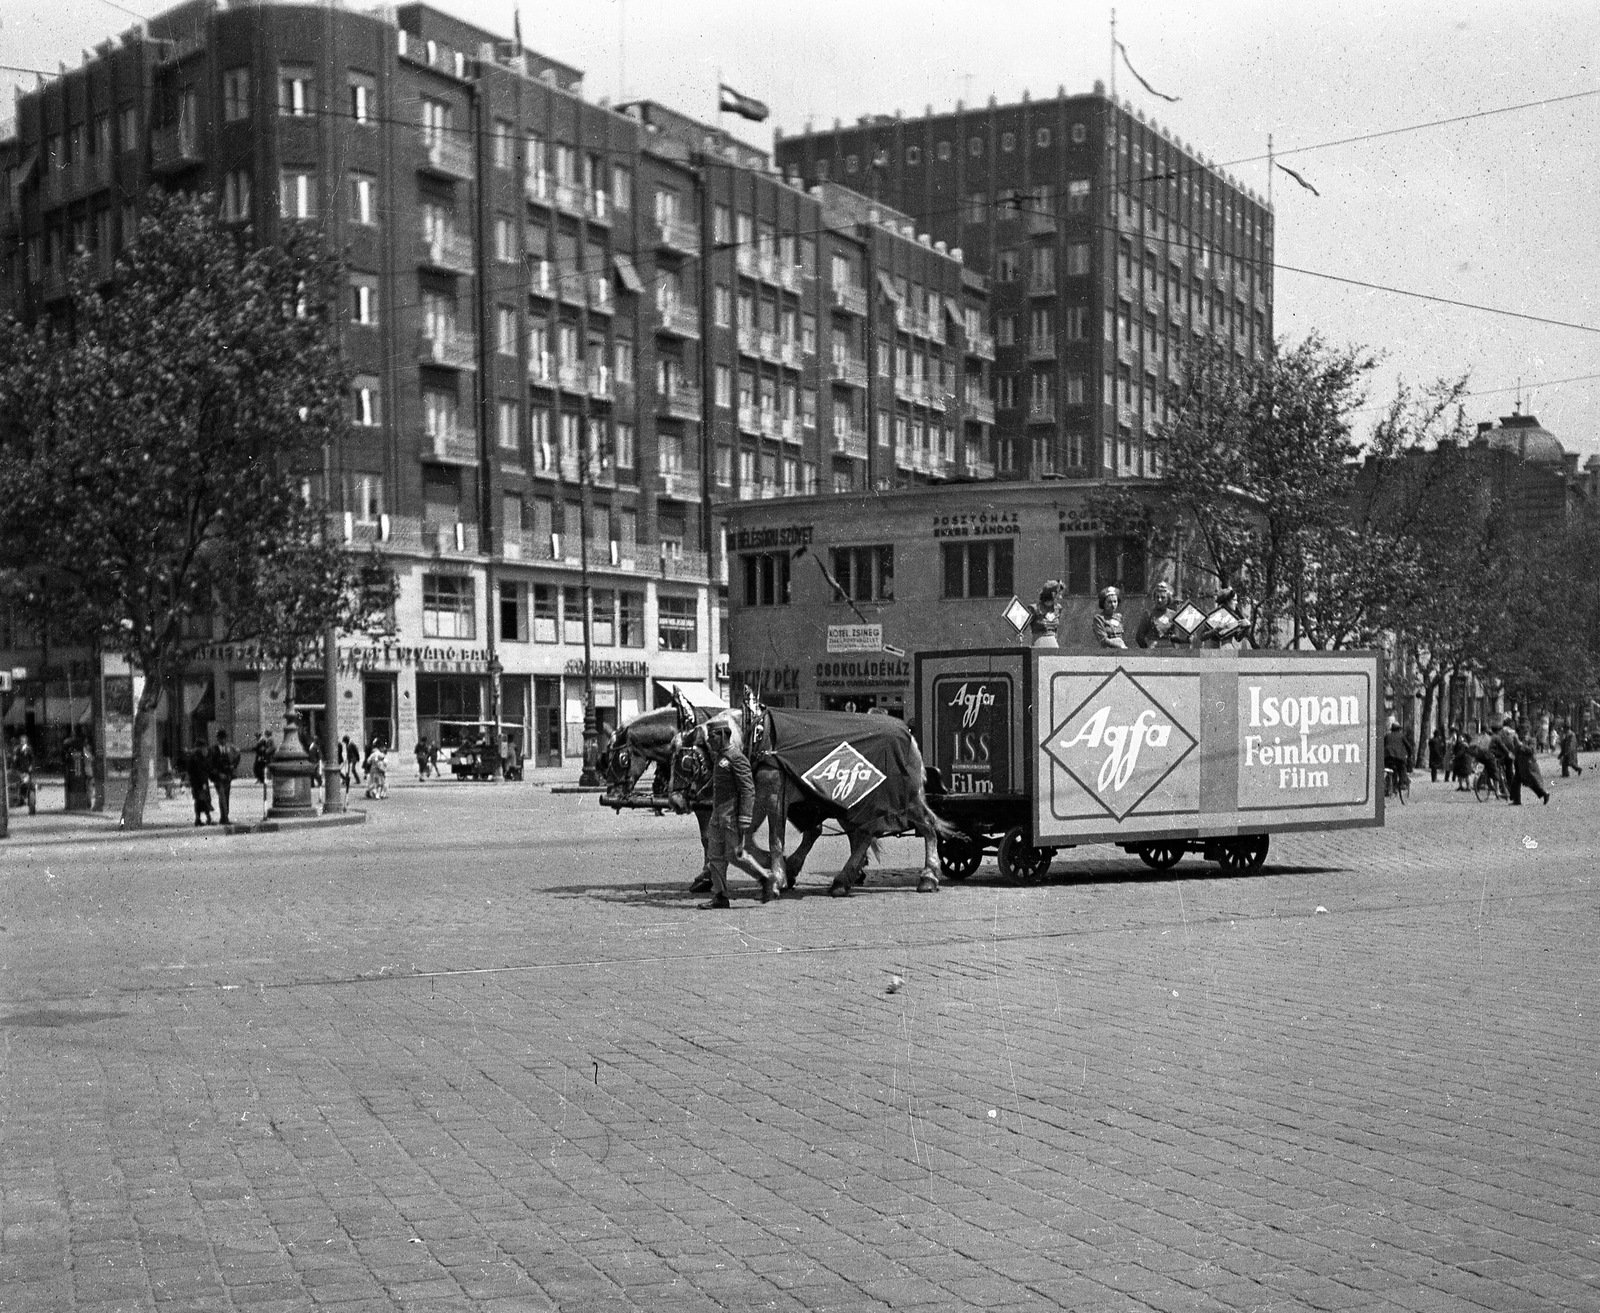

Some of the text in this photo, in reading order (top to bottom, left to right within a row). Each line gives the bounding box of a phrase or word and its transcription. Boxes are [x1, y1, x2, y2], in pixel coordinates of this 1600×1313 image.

[933, 509, 1019, 526] POSZTÓHÁZ
[974, 523, 1020, 536] SÁNDOR
[816, 658, 910, 677] CSOKOLÁDÉHÁZ
[948, 682, 995, 728] Agfa
[1248, 686, 1360, 734] Isopan
[953, 731, 990, 762] ISS
[1060, 706, 1171, 792] Agfa
[1244, 734, 1361, 766] Feinkorn
[812, 759, 872, 801] Agfa
[951, 773, 994, 794] Film
[1278, 767, 1329, 789] Film
